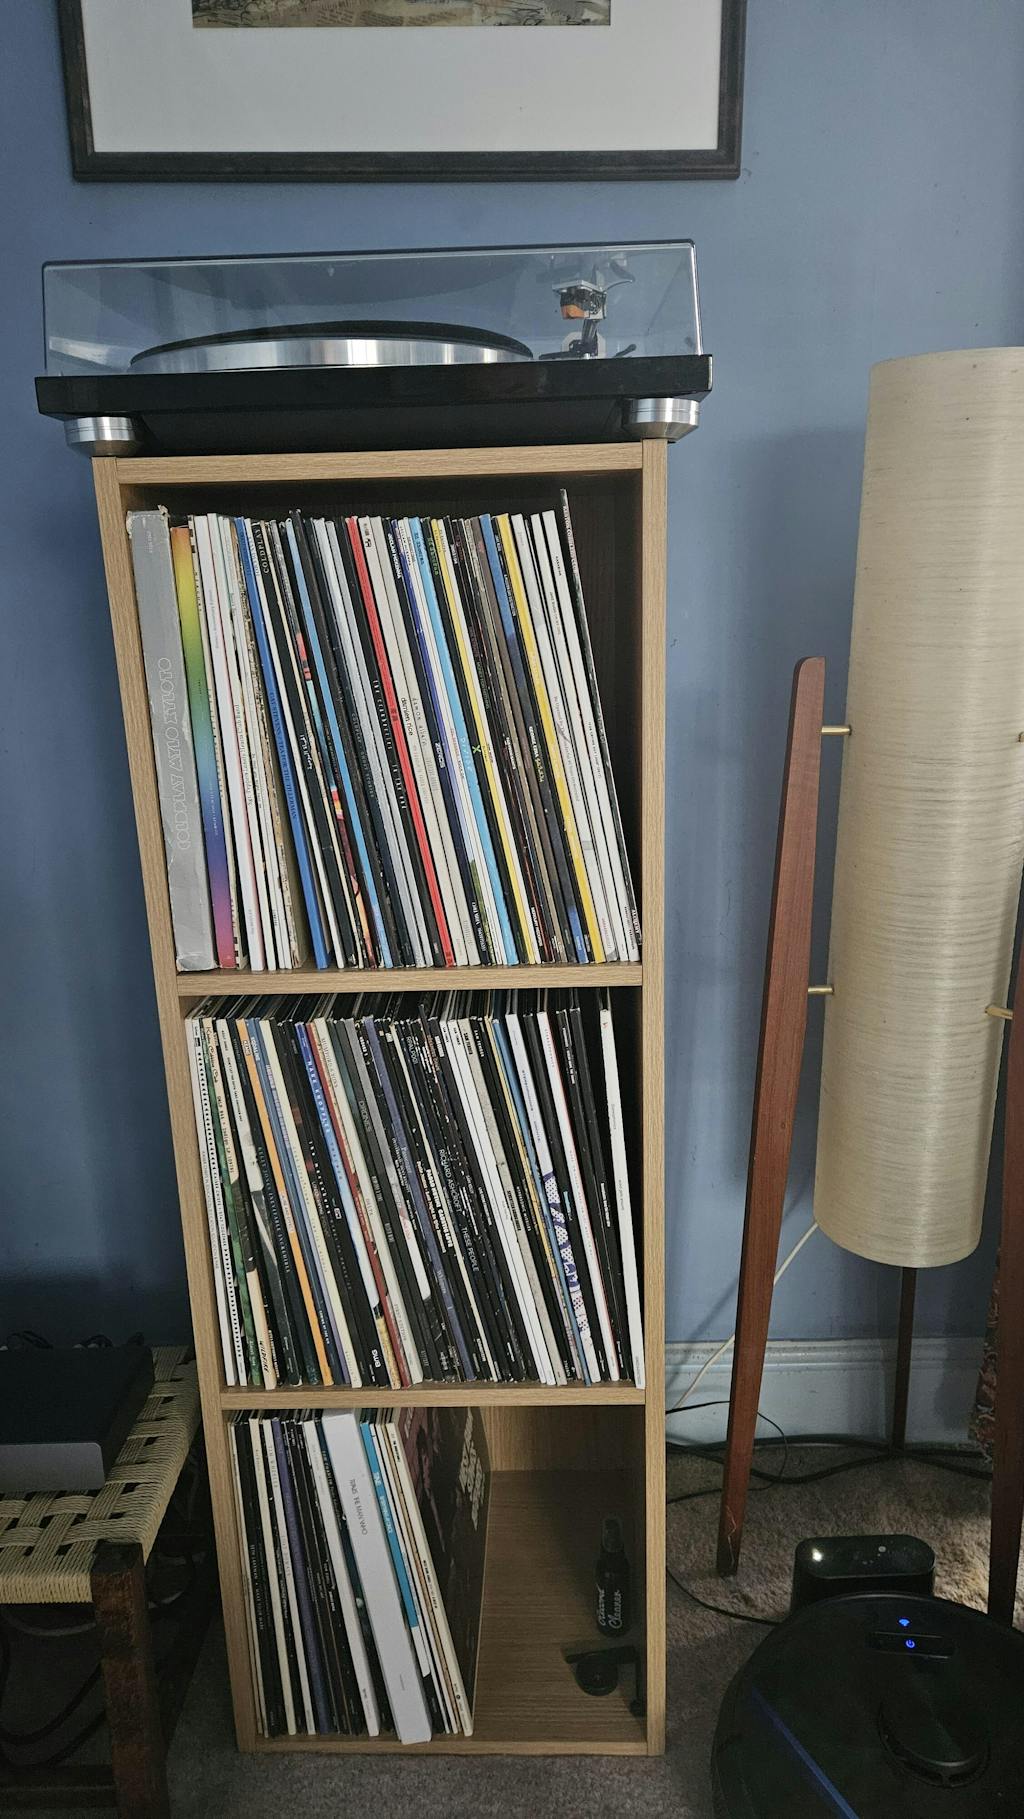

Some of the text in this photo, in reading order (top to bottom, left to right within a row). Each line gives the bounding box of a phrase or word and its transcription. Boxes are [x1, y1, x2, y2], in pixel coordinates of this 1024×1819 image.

[253, 527, 270, 573] COLDPLAY
[232, 703, 242, 718] Band
[267, 691, 277, 705] CAT
[234, 718, 244, 733] Club
[270, 705, 282, 735] STEVENS
[349, 712, 362, 743] COLDPLAY
[399, 696, 415, 736] damien rice
[156, 656, 191, 849] COLDPLAY MYLO XYLOTO
[276, 741, 286, 754] TEA
[278, 754, 288, 767] FOR
[281, 768, 291, 782] THE
[284, 783, 297, 818] TILLERMAN
[475, 1040, 485, 1057] FENDER
[306, 1060, 331, 1133] MARK KNOPFLER
[357, 1100, 372, 1132] DRONES
[400, 1146, 412, 1174] Passenger
[437, 1148, 453, 1178] RICHARD
[425, 1168, 436, 1187] PAOLO
[430, 1187, 441, 1207] NUTINI
[446, 1179, 463, 1212] ASHCROFT
[267, 1192, 282, 1231] INEVITABLE
[276, 1233, 291, 1273] INCREDIBLE
[435, 1208, 449, 1232] CAUSTIC
[442, 1232, 453, 1247] LOVE
[461, 1226, 472, 1246] THESE
[466, 1247, 479, 1272] PEOPLE
[258, 1340, 269, 1372] WILDFIRE
[608, 1589, 623, 1629] Cleaner
